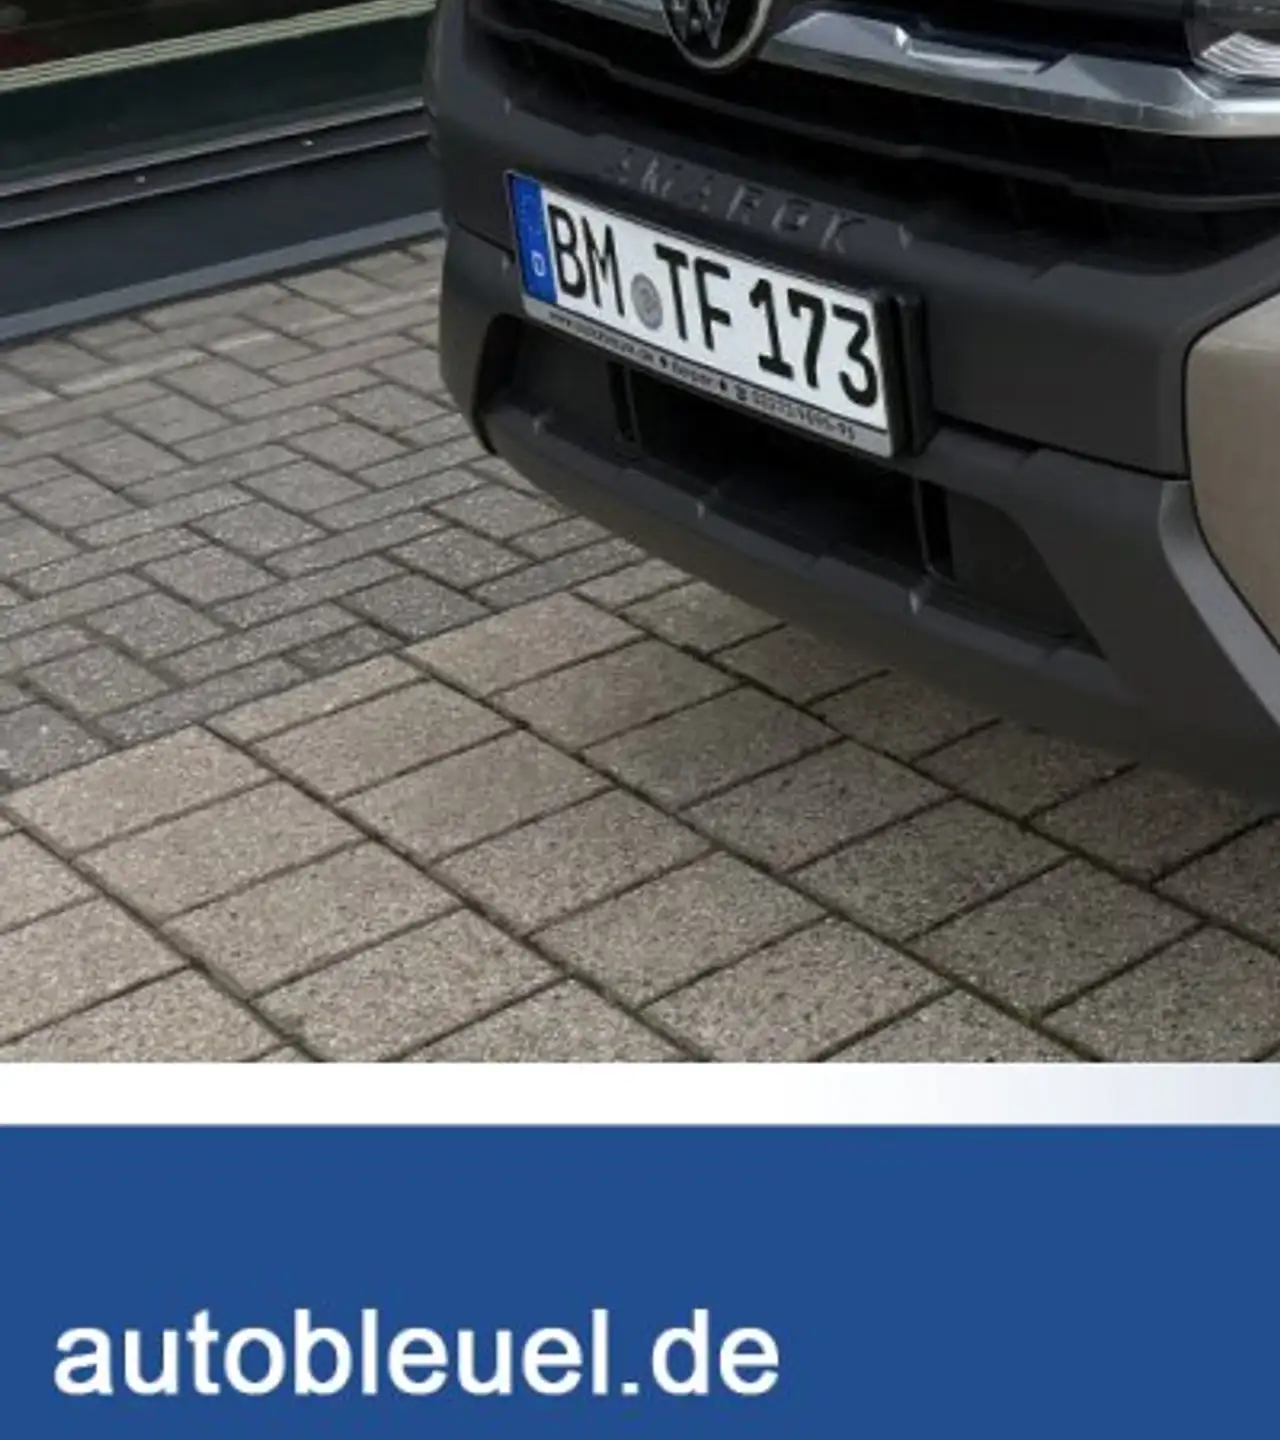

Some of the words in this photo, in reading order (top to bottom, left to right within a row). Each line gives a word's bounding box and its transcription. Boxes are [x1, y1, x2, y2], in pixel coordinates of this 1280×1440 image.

[548, 203, 626, 317] BM
[653, 241, 731, 351] TF
[749, 278, 879, 408] 173
